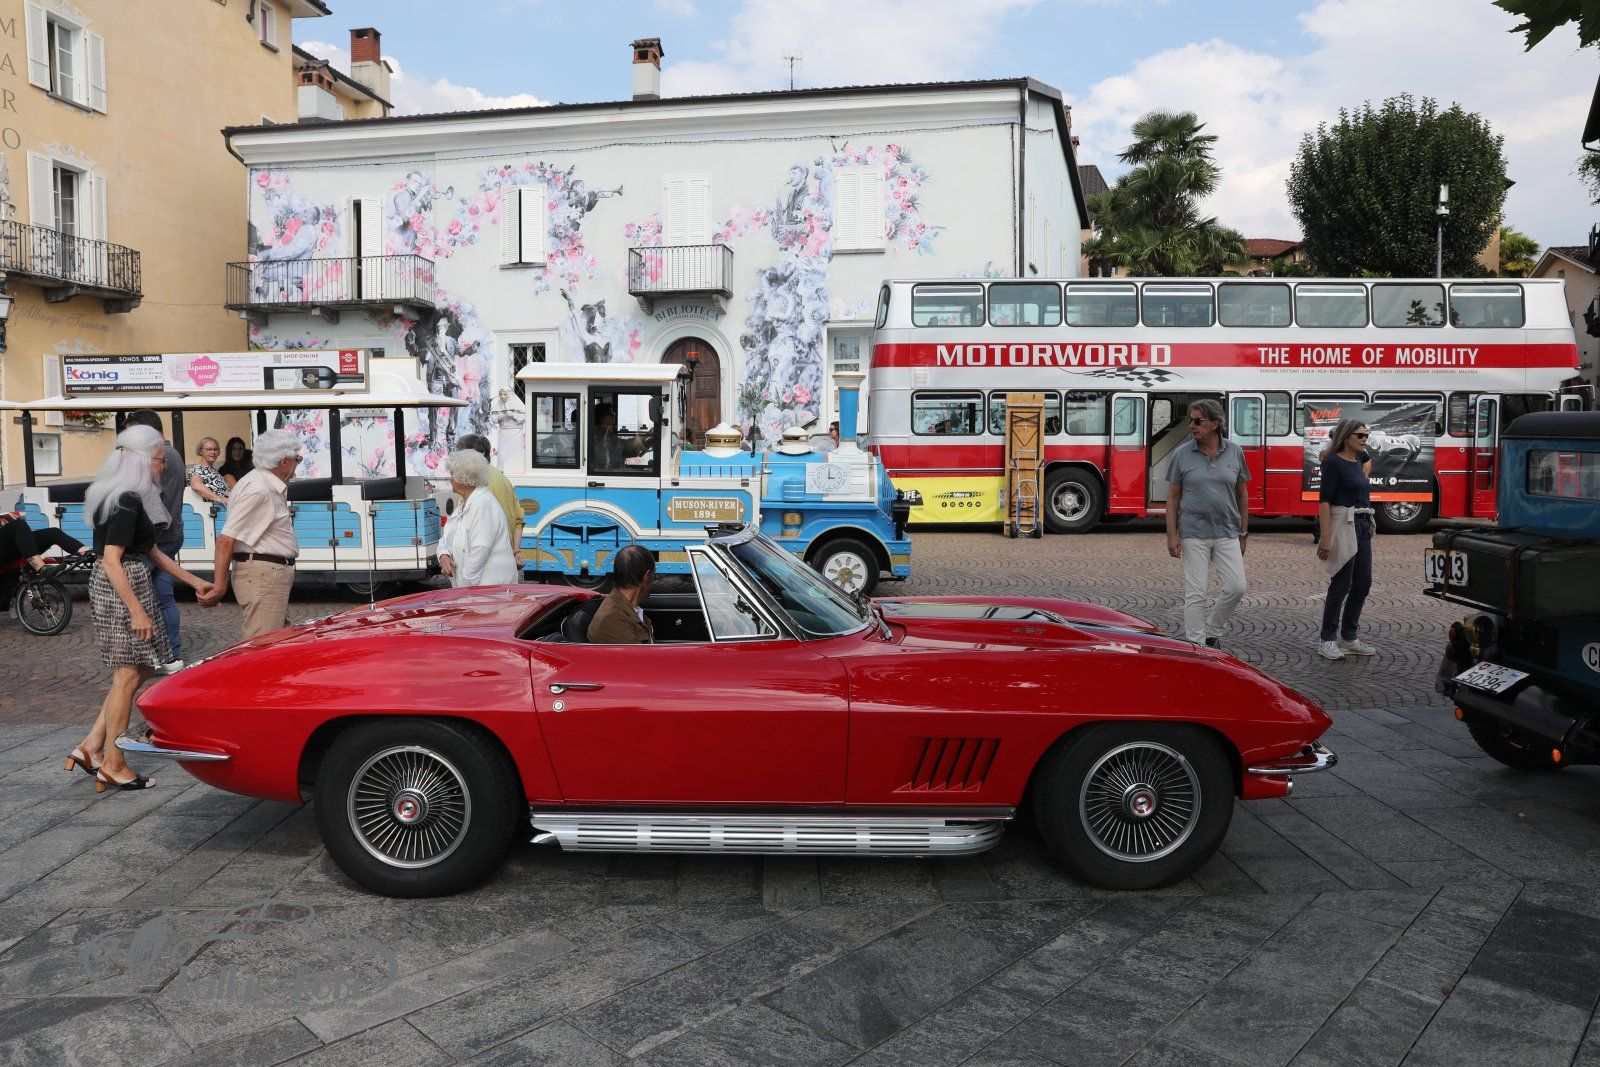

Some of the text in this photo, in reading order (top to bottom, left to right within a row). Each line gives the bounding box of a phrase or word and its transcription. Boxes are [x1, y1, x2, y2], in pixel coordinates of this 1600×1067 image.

[654, 305, 719, 322] BIBLIOTECA
[936, 344, 1171, 366] MOTORWORLD
[1258, 347, 1479, 364] THE HOME OF MOBILITY
[71, 369, 119, 381] König
[693, 510, 717, 519] 1894
[1430, 554, 1465, 581] 1913
